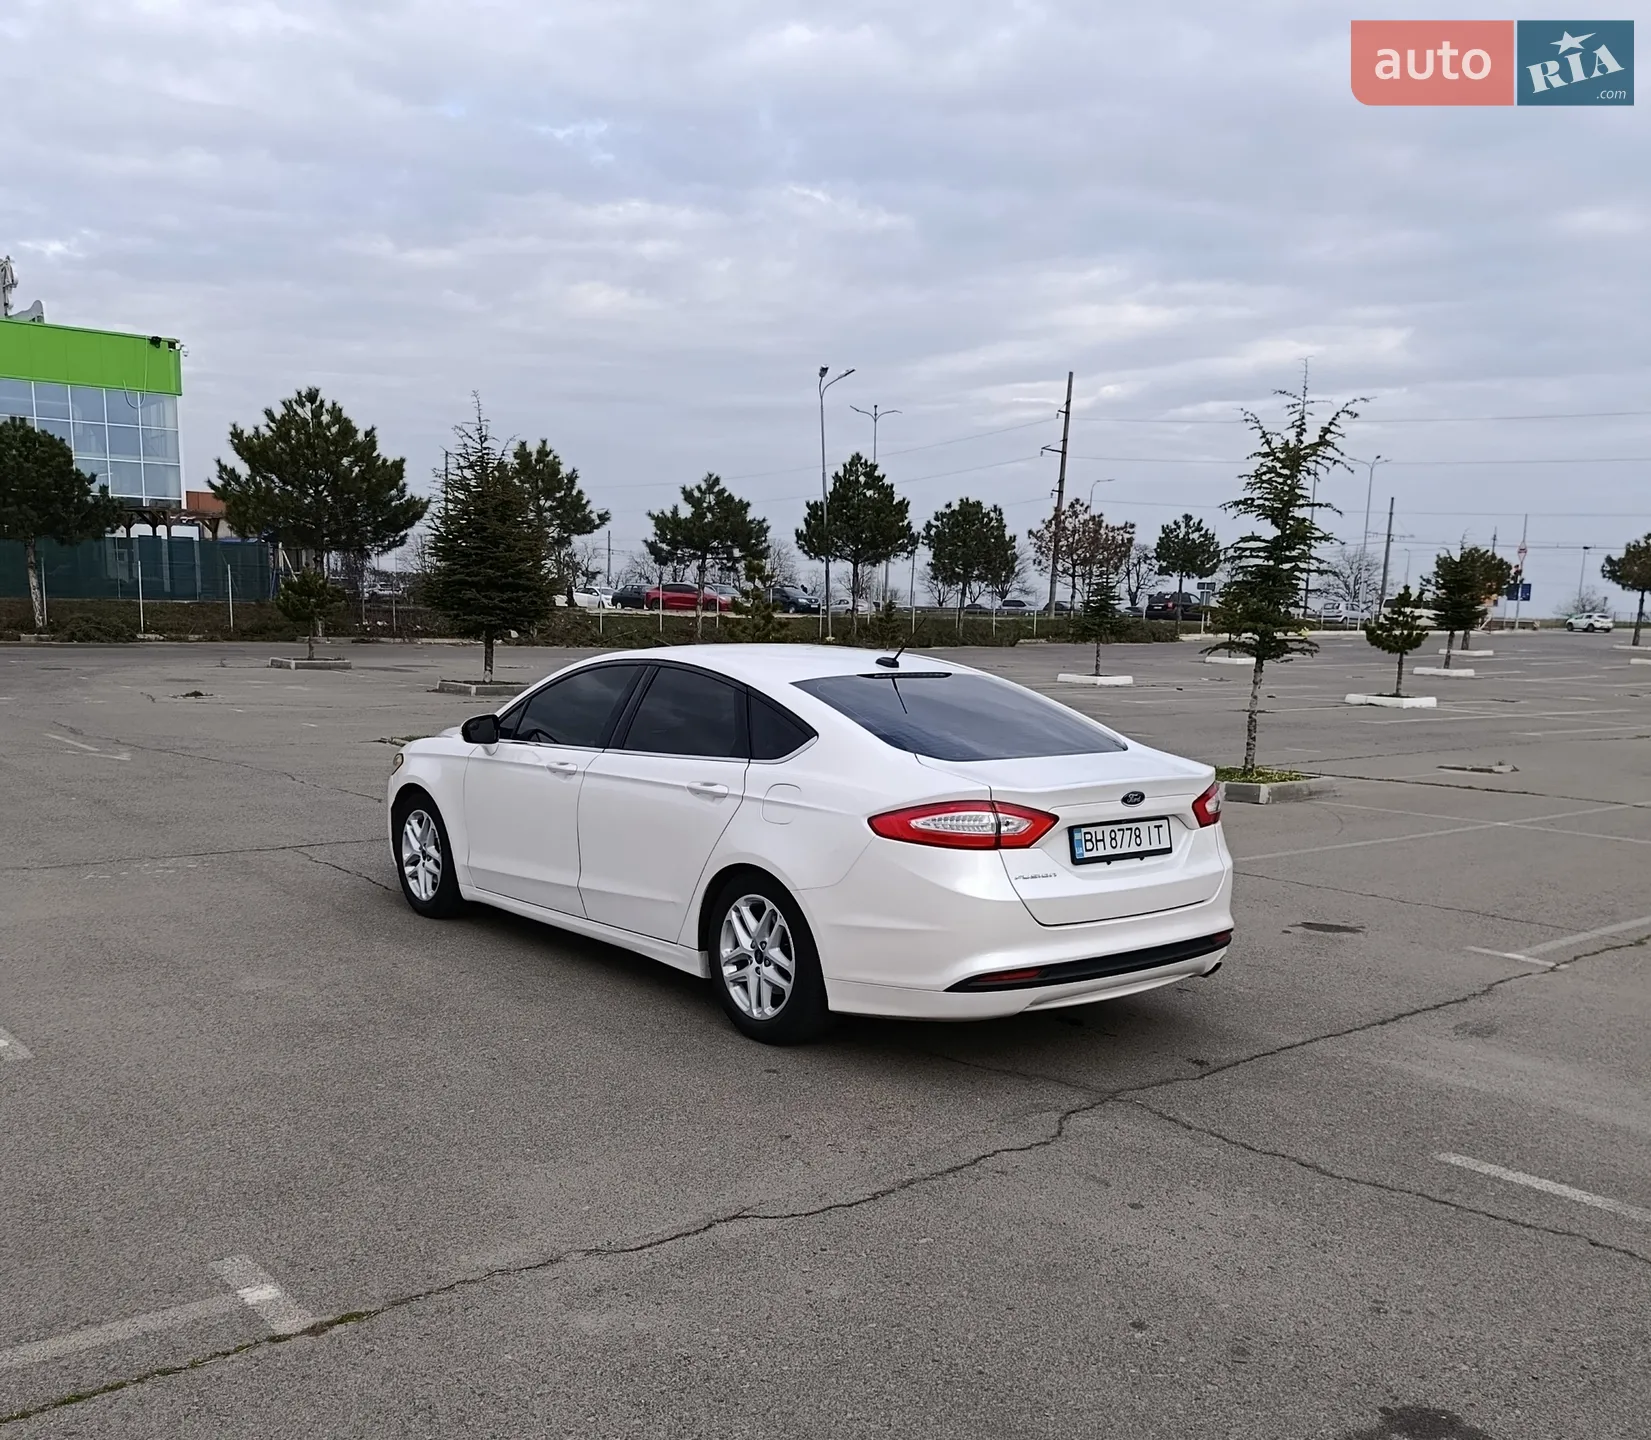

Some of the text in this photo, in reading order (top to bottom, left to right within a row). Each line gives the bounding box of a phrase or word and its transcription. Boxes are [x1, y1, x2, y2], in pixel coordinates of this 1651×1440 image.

[1083, 824, 1163, 852] BH 8778 IT
